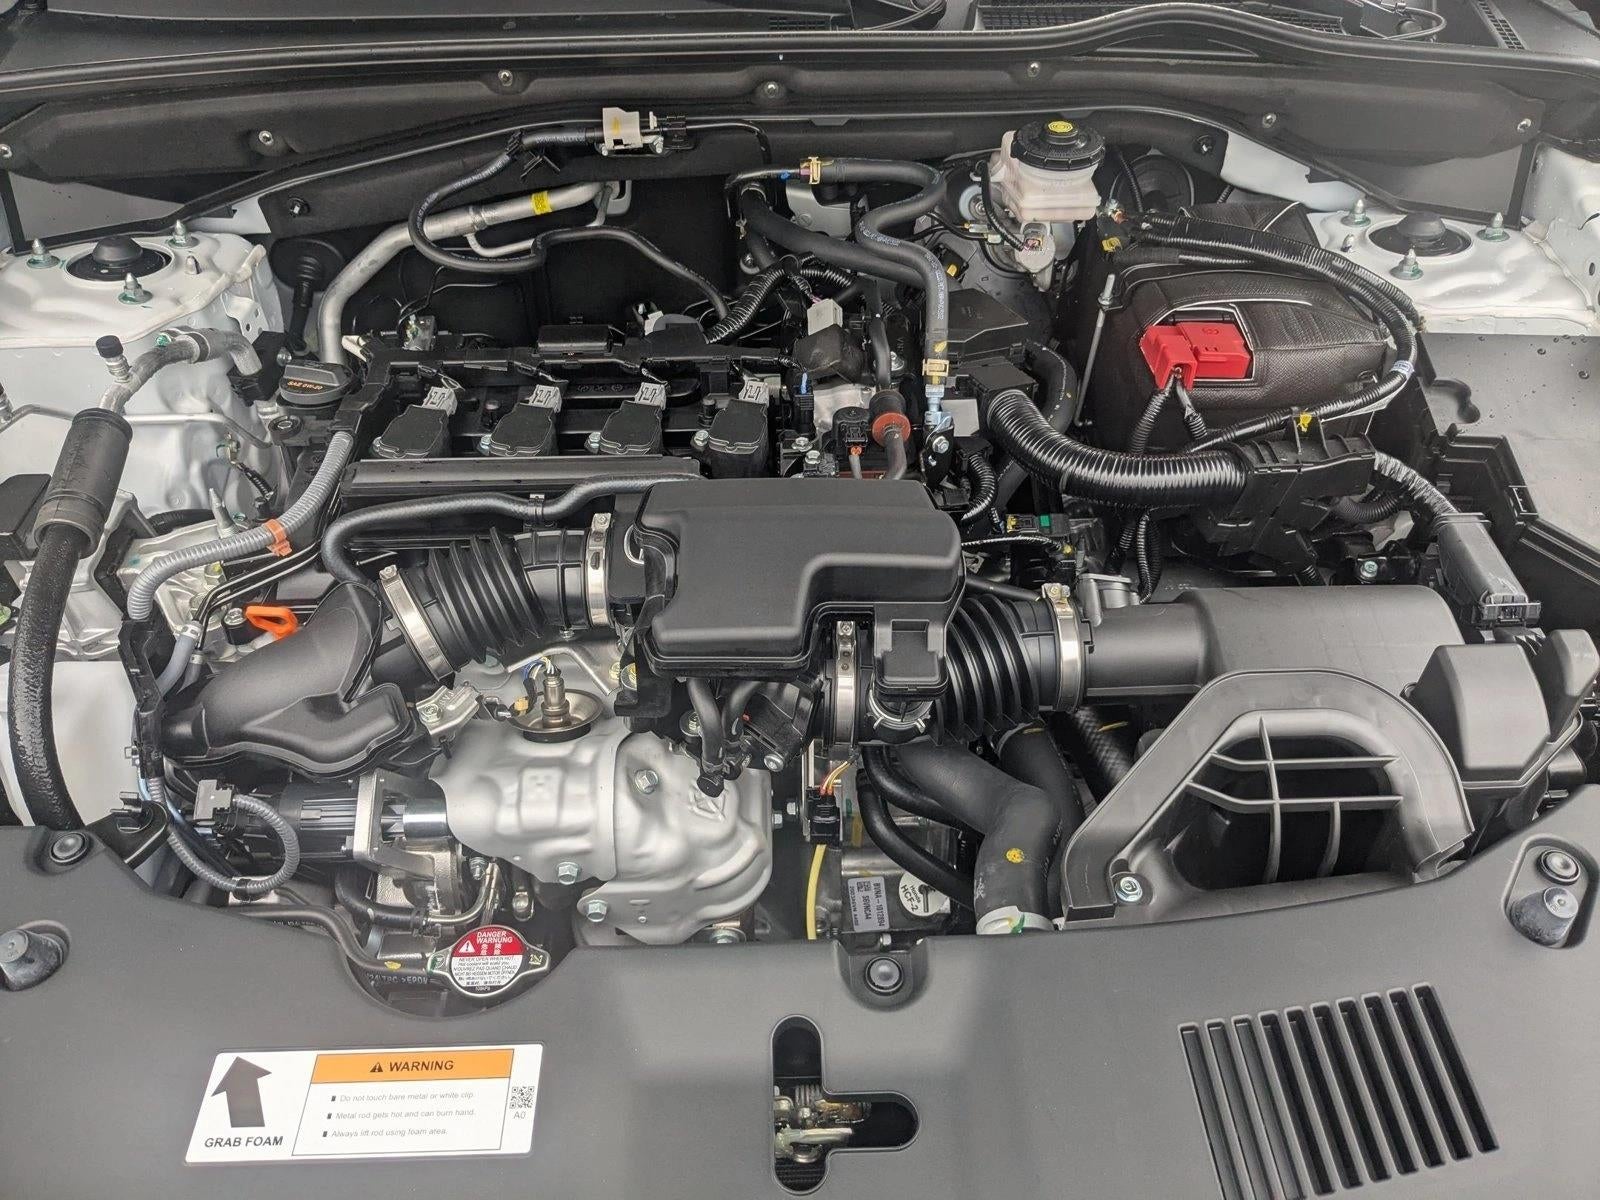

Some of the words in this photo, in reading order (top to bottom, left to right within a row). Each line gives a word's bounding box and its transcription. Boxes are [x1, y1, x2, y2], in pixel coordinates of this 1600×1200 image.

[900, 884, 919, 912] HCF-2
[477, 936, 513, 944] WARNUNG
[389, 1060, 454, 1072] WARNING
[372, 1112, 389, 1120] gets
[404, 1110, 419, 1118] and
[436, 1109, 453, 1117] burn
[513, 1111, 526, 1119] A0
[331, 1130, 359, 1138] Always
[385, 1129, 406, 1137] using
[204, 1137, 242, 1148] GRAB
[245, 1136, 284, 1147] FOAM
